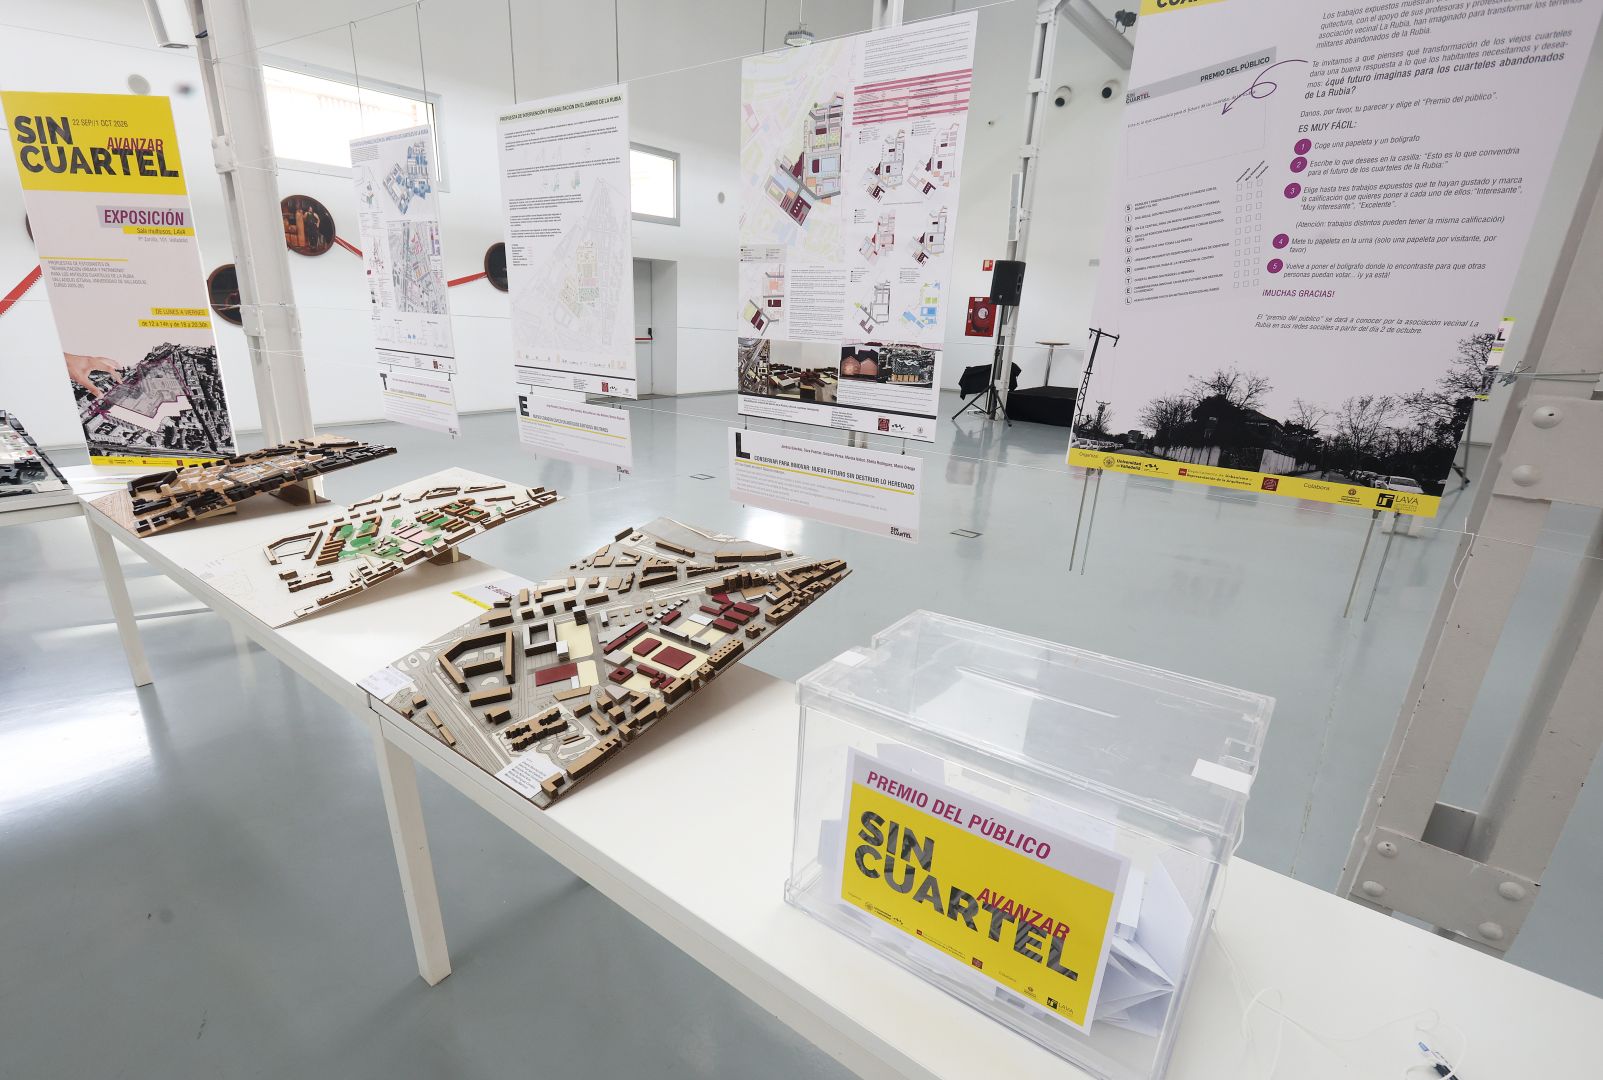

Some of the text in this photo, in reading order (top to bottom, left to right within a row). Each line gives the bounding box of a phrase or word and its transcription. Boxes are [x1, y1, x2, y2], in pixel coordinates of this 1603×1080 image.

[1322, 56, 1352, 67] invitamos
[1377, 51, 1403, 60] pienses
[1422, 40, 1478, 54] transformación
[1509, 35, 1531, 44] viejos
[1534, 29, 1572, 40] cuarteles
[1200, 56, 1270, 82] PREMIO DEL PÚBLICO
[1325, 75, 1345, 87] ¿qué
[1347, 74, 1371, 84] futuro
[1374, 70, 1411, 81] imaginas
[1414, 67, 1434, 77] para
[1437, 66, 1450, 74] los
[1453, 60, 1496, 72] cuarteles
[1500, 51, 1564, 67] abandonados
[1126, 93, 1150, 104] CUARTEL
[1304, 85, 1356, 99] de La Rubia?
[1363, 103, 1388, 112] parecer
[1396, 100, 1412, 109] elige
[14, 116, 73, 145] SIN
[1298, 119, 1358, 133] ES MUY FÁCIL:
[107, 137, 163, 151] AVANZAR
[1345, 139, 1372, 148] papeleta
[1390, 134, 1420, 144] bolígrafo
[20, 146, 179, 178] CUARTEL
[1310, 160, 1334, 168] Escribe
[1342, 158, 1353, 166] que
[1356, 156, 1378, 164] desees
[1464, 149, 1477, 158] que
[1352, 184, 1378, 194] trabajos
[1379, 182, 1413, 191] expuestos
[1414, 181, 1428, 189] que
[1460, 178, 1490, 187] gustado
[104, 209, 184, 225] EXPOSICIÓN
[1299, 290, 1335, 298] GRACIAS!
[380, 373, 387, 390] T
[519, 395, 529, 416] E
[736, 432, 750, 459] L
[754, 455, 779, 466] CONSERVAR
[779, 459, 790, 468] PARA
[811, 466, 827, 475] NUEVO
[828, 468, 846, 478] FUTURO
[855, 472, 880, 484] DESTRUIR
[880, 477, 887, 485] LO
[887, 478, 915, 491] HEREDADO
[1303, 482, 1330, 491] Colabora
[1395, 496, 1418, 505] LAVA
[890, 531, 912, 539] CUARTEL
[866, 770, 1052, 860] PREMIO DEL PÚBLICO
[858, 810, 935, 872] SIN
[854, 844, 1079, 982] CUARTEL
[976, 887, 1071, 942] AVANZAR
[1059, 1003, 1073, 1014] LAVA
